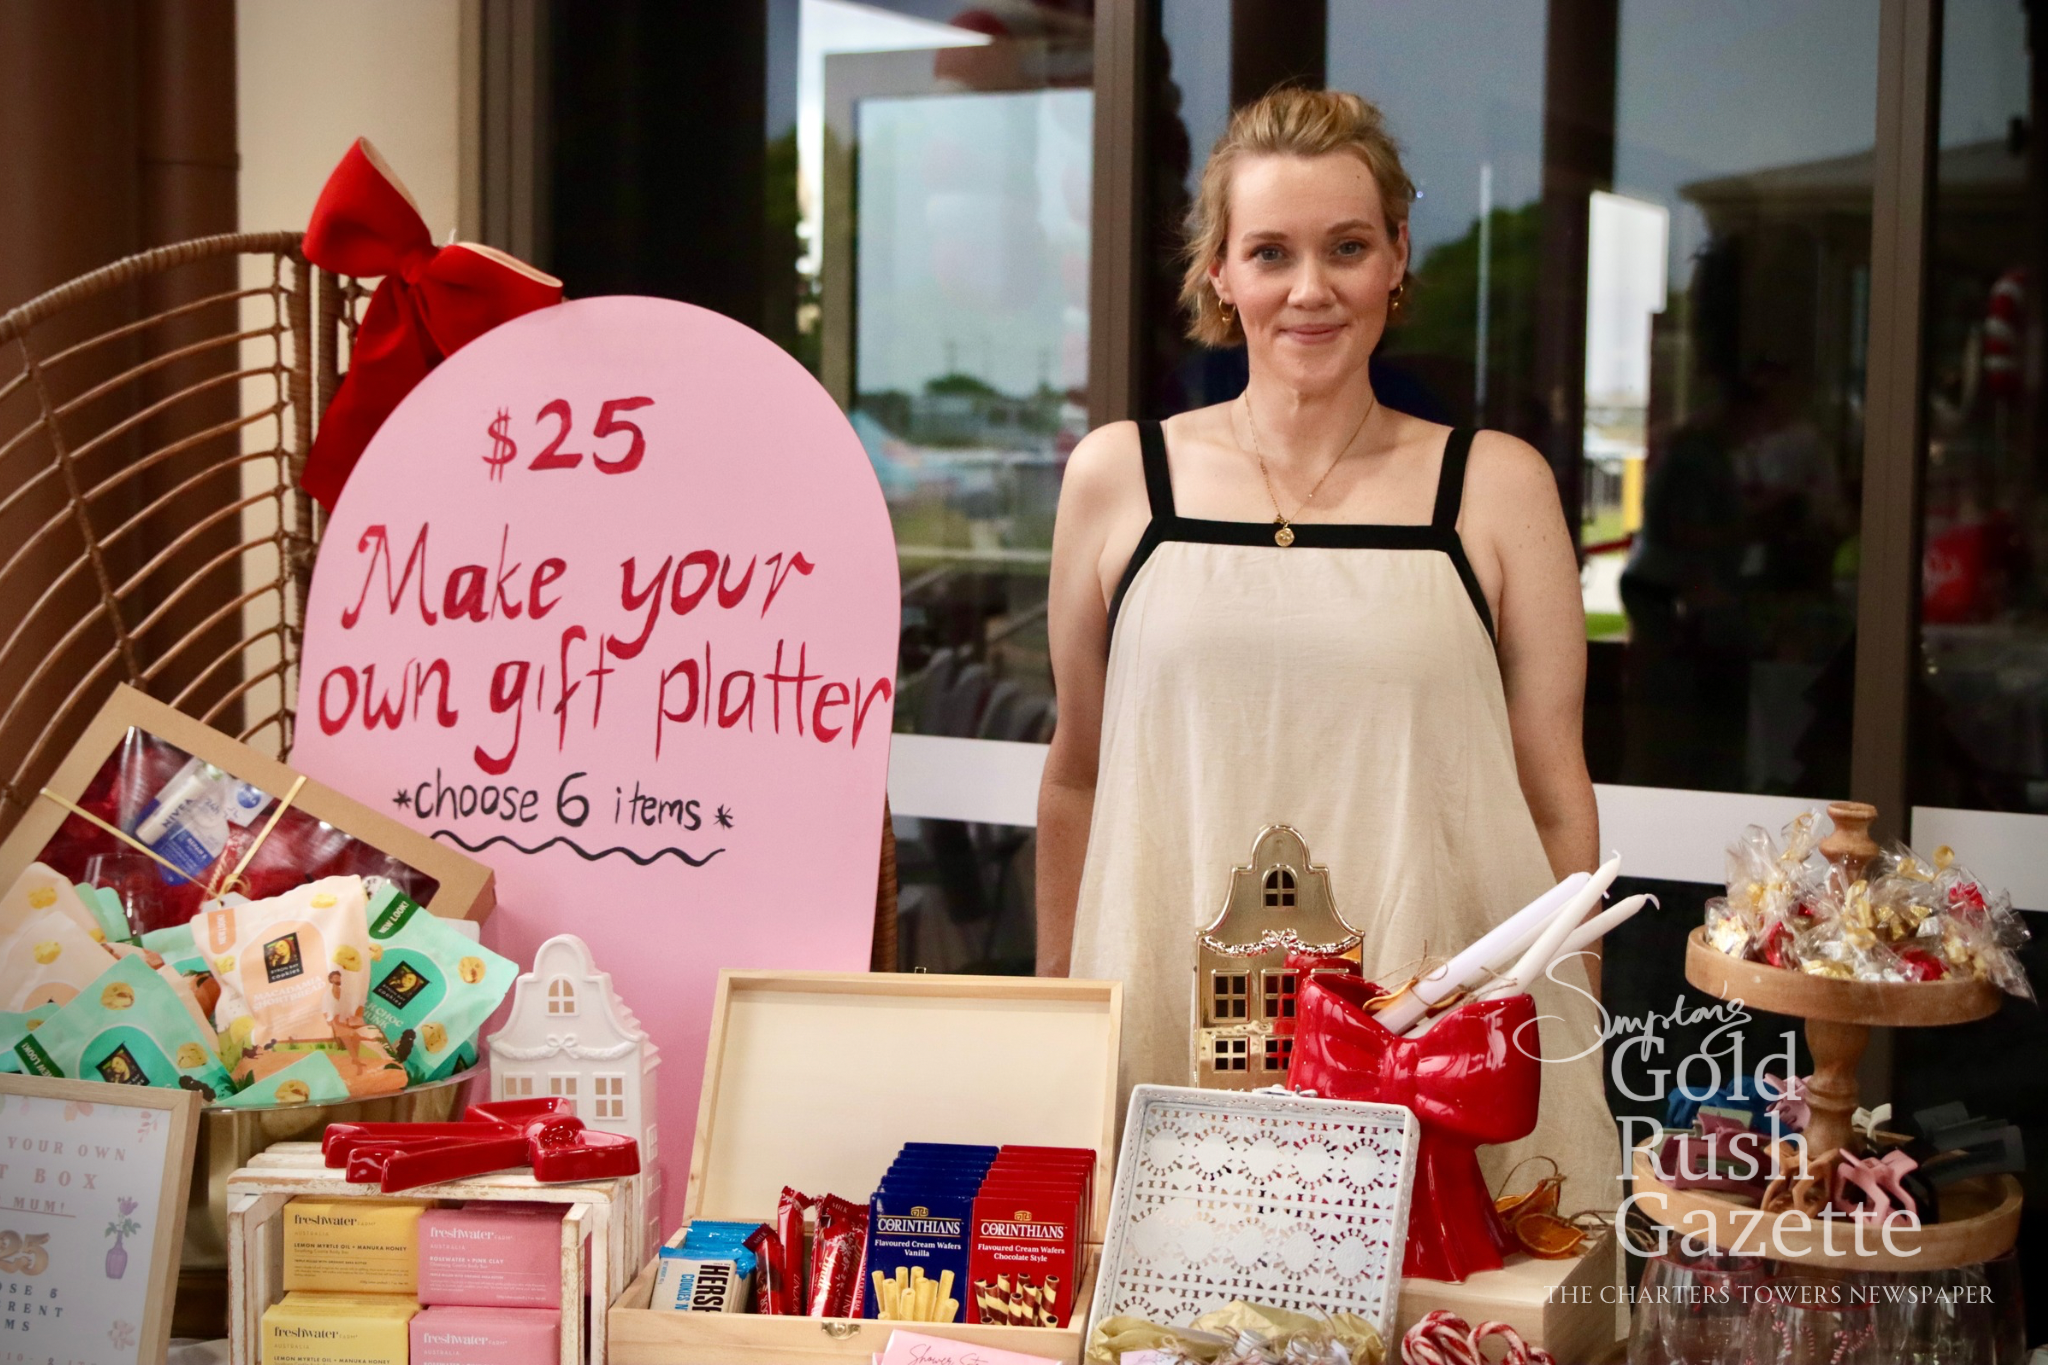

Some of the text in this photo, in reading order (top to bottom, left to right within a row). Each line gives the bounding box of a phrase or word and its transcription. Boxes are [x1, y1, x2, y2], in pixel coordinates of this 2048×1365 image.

[482, 396, 655, 482] $25
[341, 522, 815, 659] Make your
[318, 625, 892, 775] own gift platter
[556, 772, 590, 827] 6
[615, 782, 702, 830] items
[378, 900, 410, 934] NEW LOOK!
[271, 968, 301, 980] cookies
[8, 1136, 126, 1161] YOUR OWN
[34, 1167, 97, 1190] BOX
[13, 1196, 65, 1213] MUM!
[294, 1214, 357, 1226] freshwater
[877, 1218, 961, 1235] CORINTHIANS
[430, 1227, 495, 1240] freshwater
[981, 1222, 1064, 1239] CORINTHIANS
[874, 1239, 911, 1247] Flavoured
[936, 1242, 962, 1250] Wafers
[904, 1249, 930, 1257] Vanilla
[977, 1243, 1065, 1254] Flavoured Cream Wafers
[993, 1252, 1048, 1262] Chocolate Style
[676, 1273, 695, 1301] COOKIES
[274, 1326, 339, 1339] freshwater
[423, 1333, 488, 1345] freshwater
